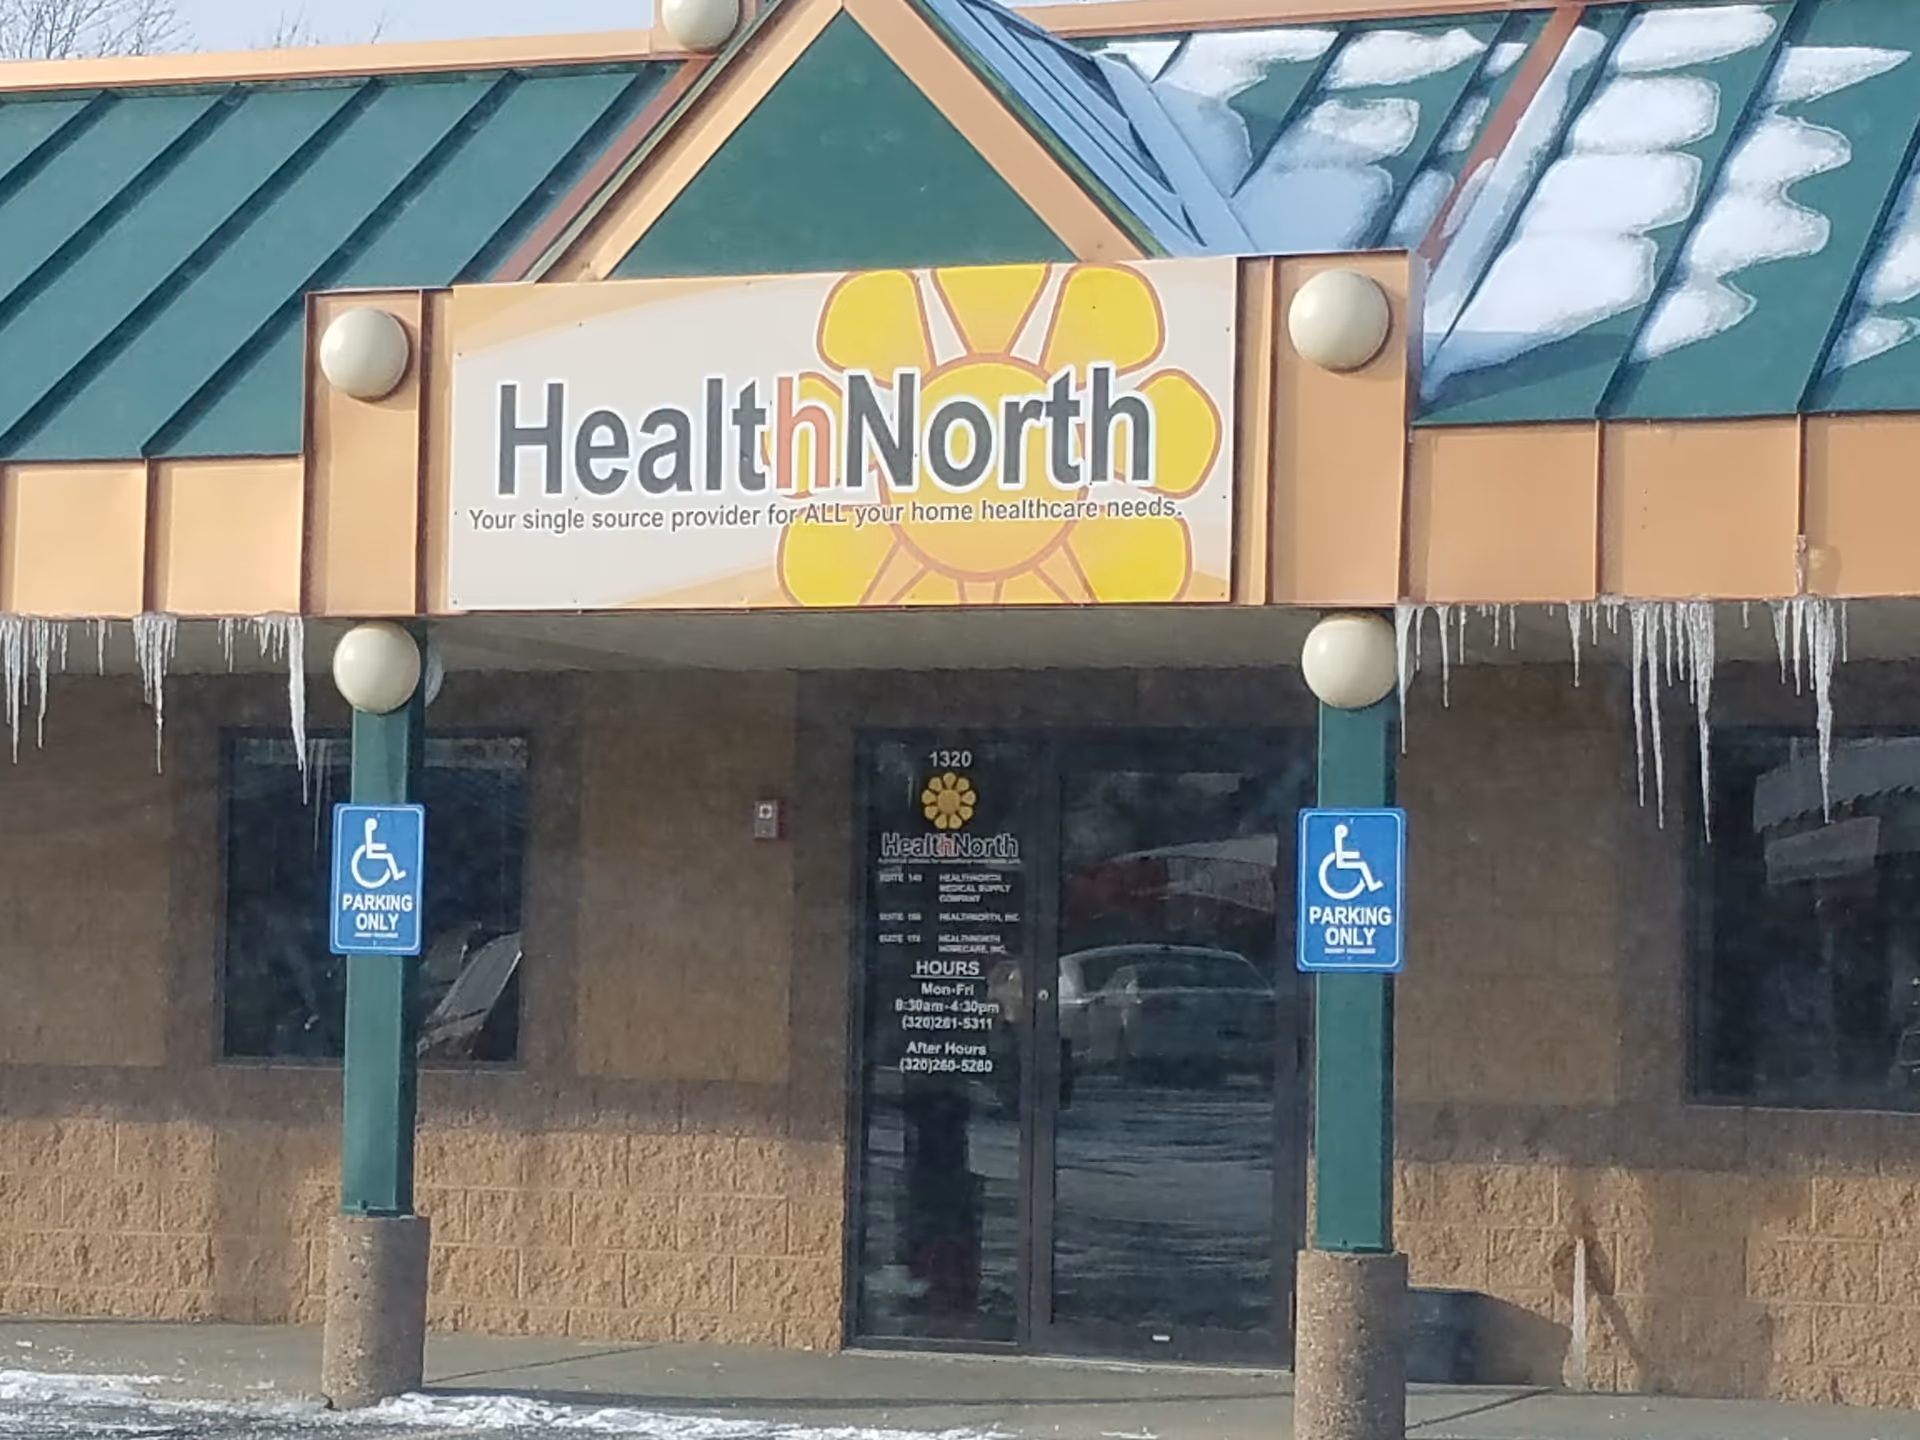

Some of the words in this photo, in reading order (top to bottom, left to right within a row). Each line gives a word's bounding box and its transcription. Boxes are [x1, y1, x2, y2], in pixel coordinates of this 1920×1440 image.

[496, 365, 1153, 497] HealthNorth
[468, 508, 517, 530] Your
[522, 508, 585, 535] single
[591, 510, 664, 529] source
[671, 504, 761, 532] provider
[767, 503, 798, 525] for
[804, 502, 847, 524] ALL
[854, 505, 904, 528] your
[911, 501, 973, 522] home
[980, 498, 1098, 520] healthcare
[1107, 496, 1183, 518] needs.
[928, 750, 973, 768] 1320
[880, 832, 1019, 858] HealthNorth
[342, 893, 413, 912] PARKING
[355, 912, 399, 931] ONLY
[1309, 906, 1393, 926] PARKING
[1324, 927, 1377, 946] ONLY
[915, 960, 981, 976] HOURS
[906, 1041, 942, 1055] After
[944, 1041, 987, 1056] Hours
